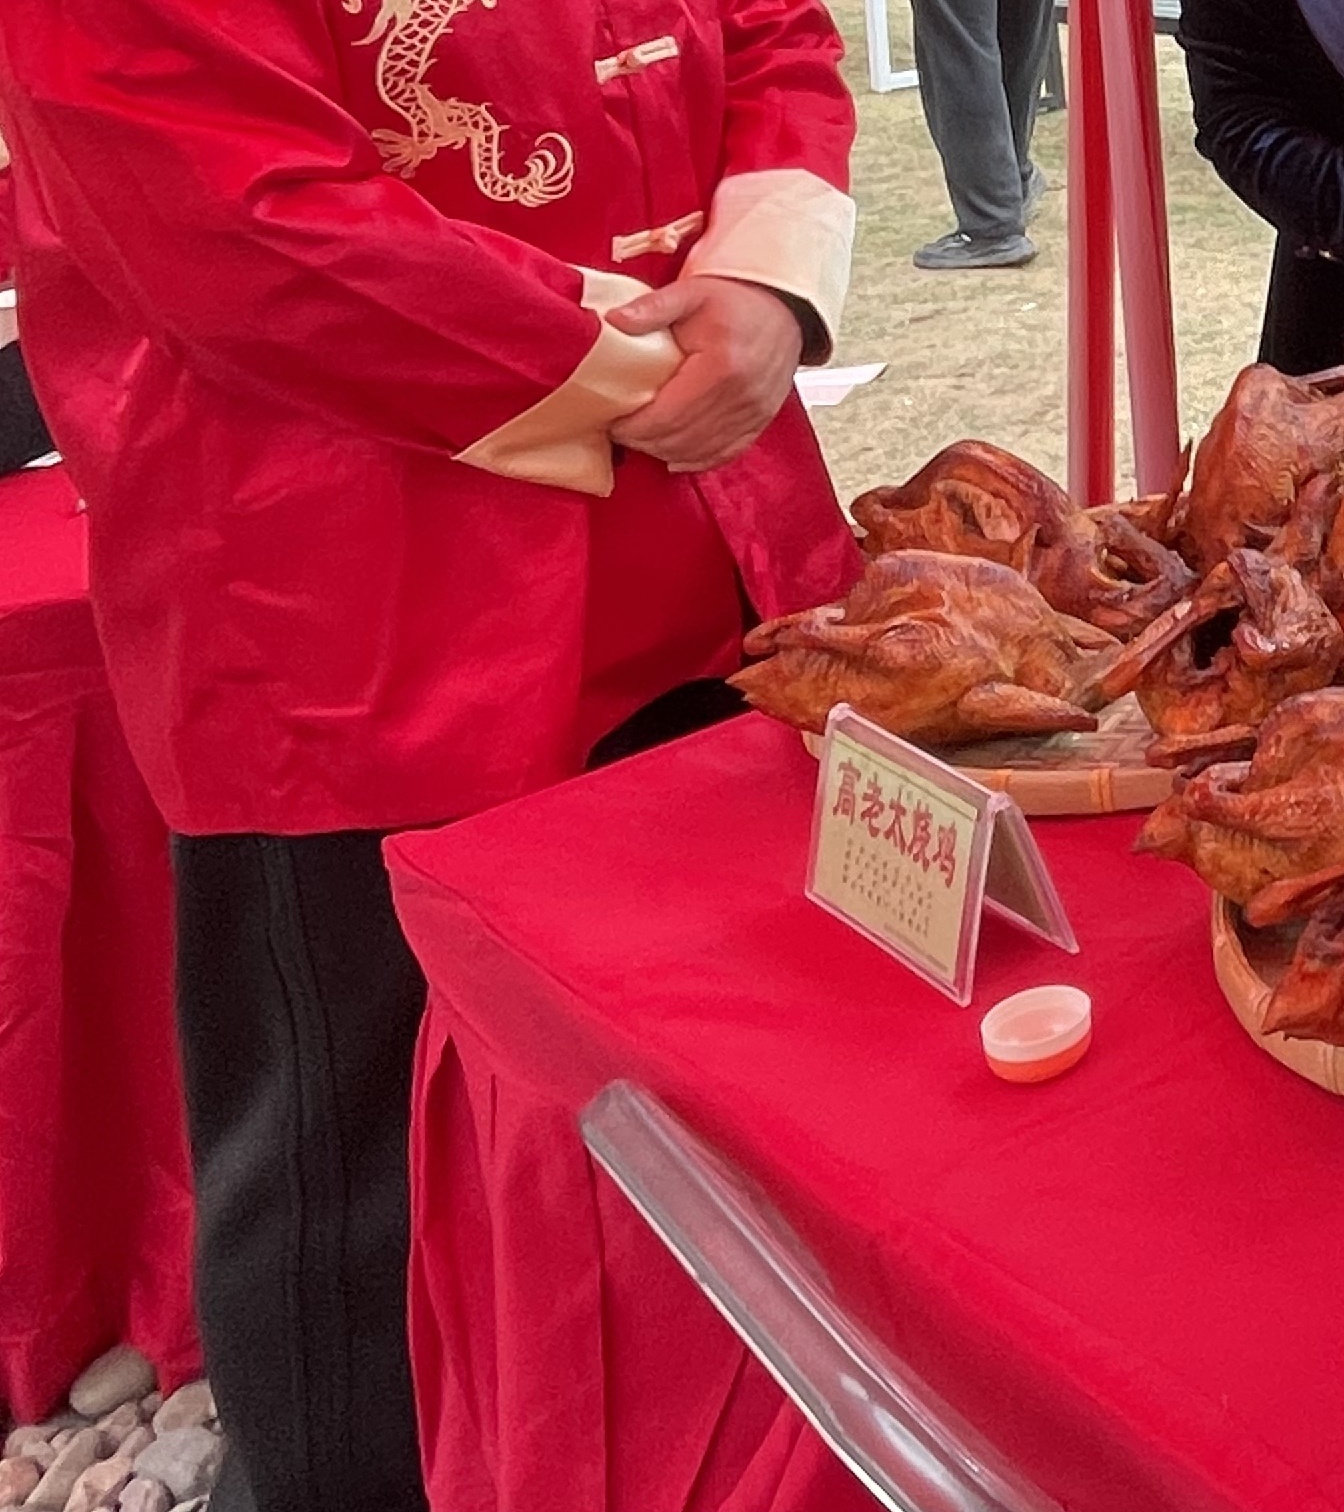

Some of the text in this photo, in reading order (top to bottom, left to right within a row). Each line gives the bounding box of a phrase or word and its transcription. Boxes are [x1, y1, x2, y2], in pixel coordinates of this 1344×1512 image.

[833, 756, 957, 888] 高老太烧鸡
